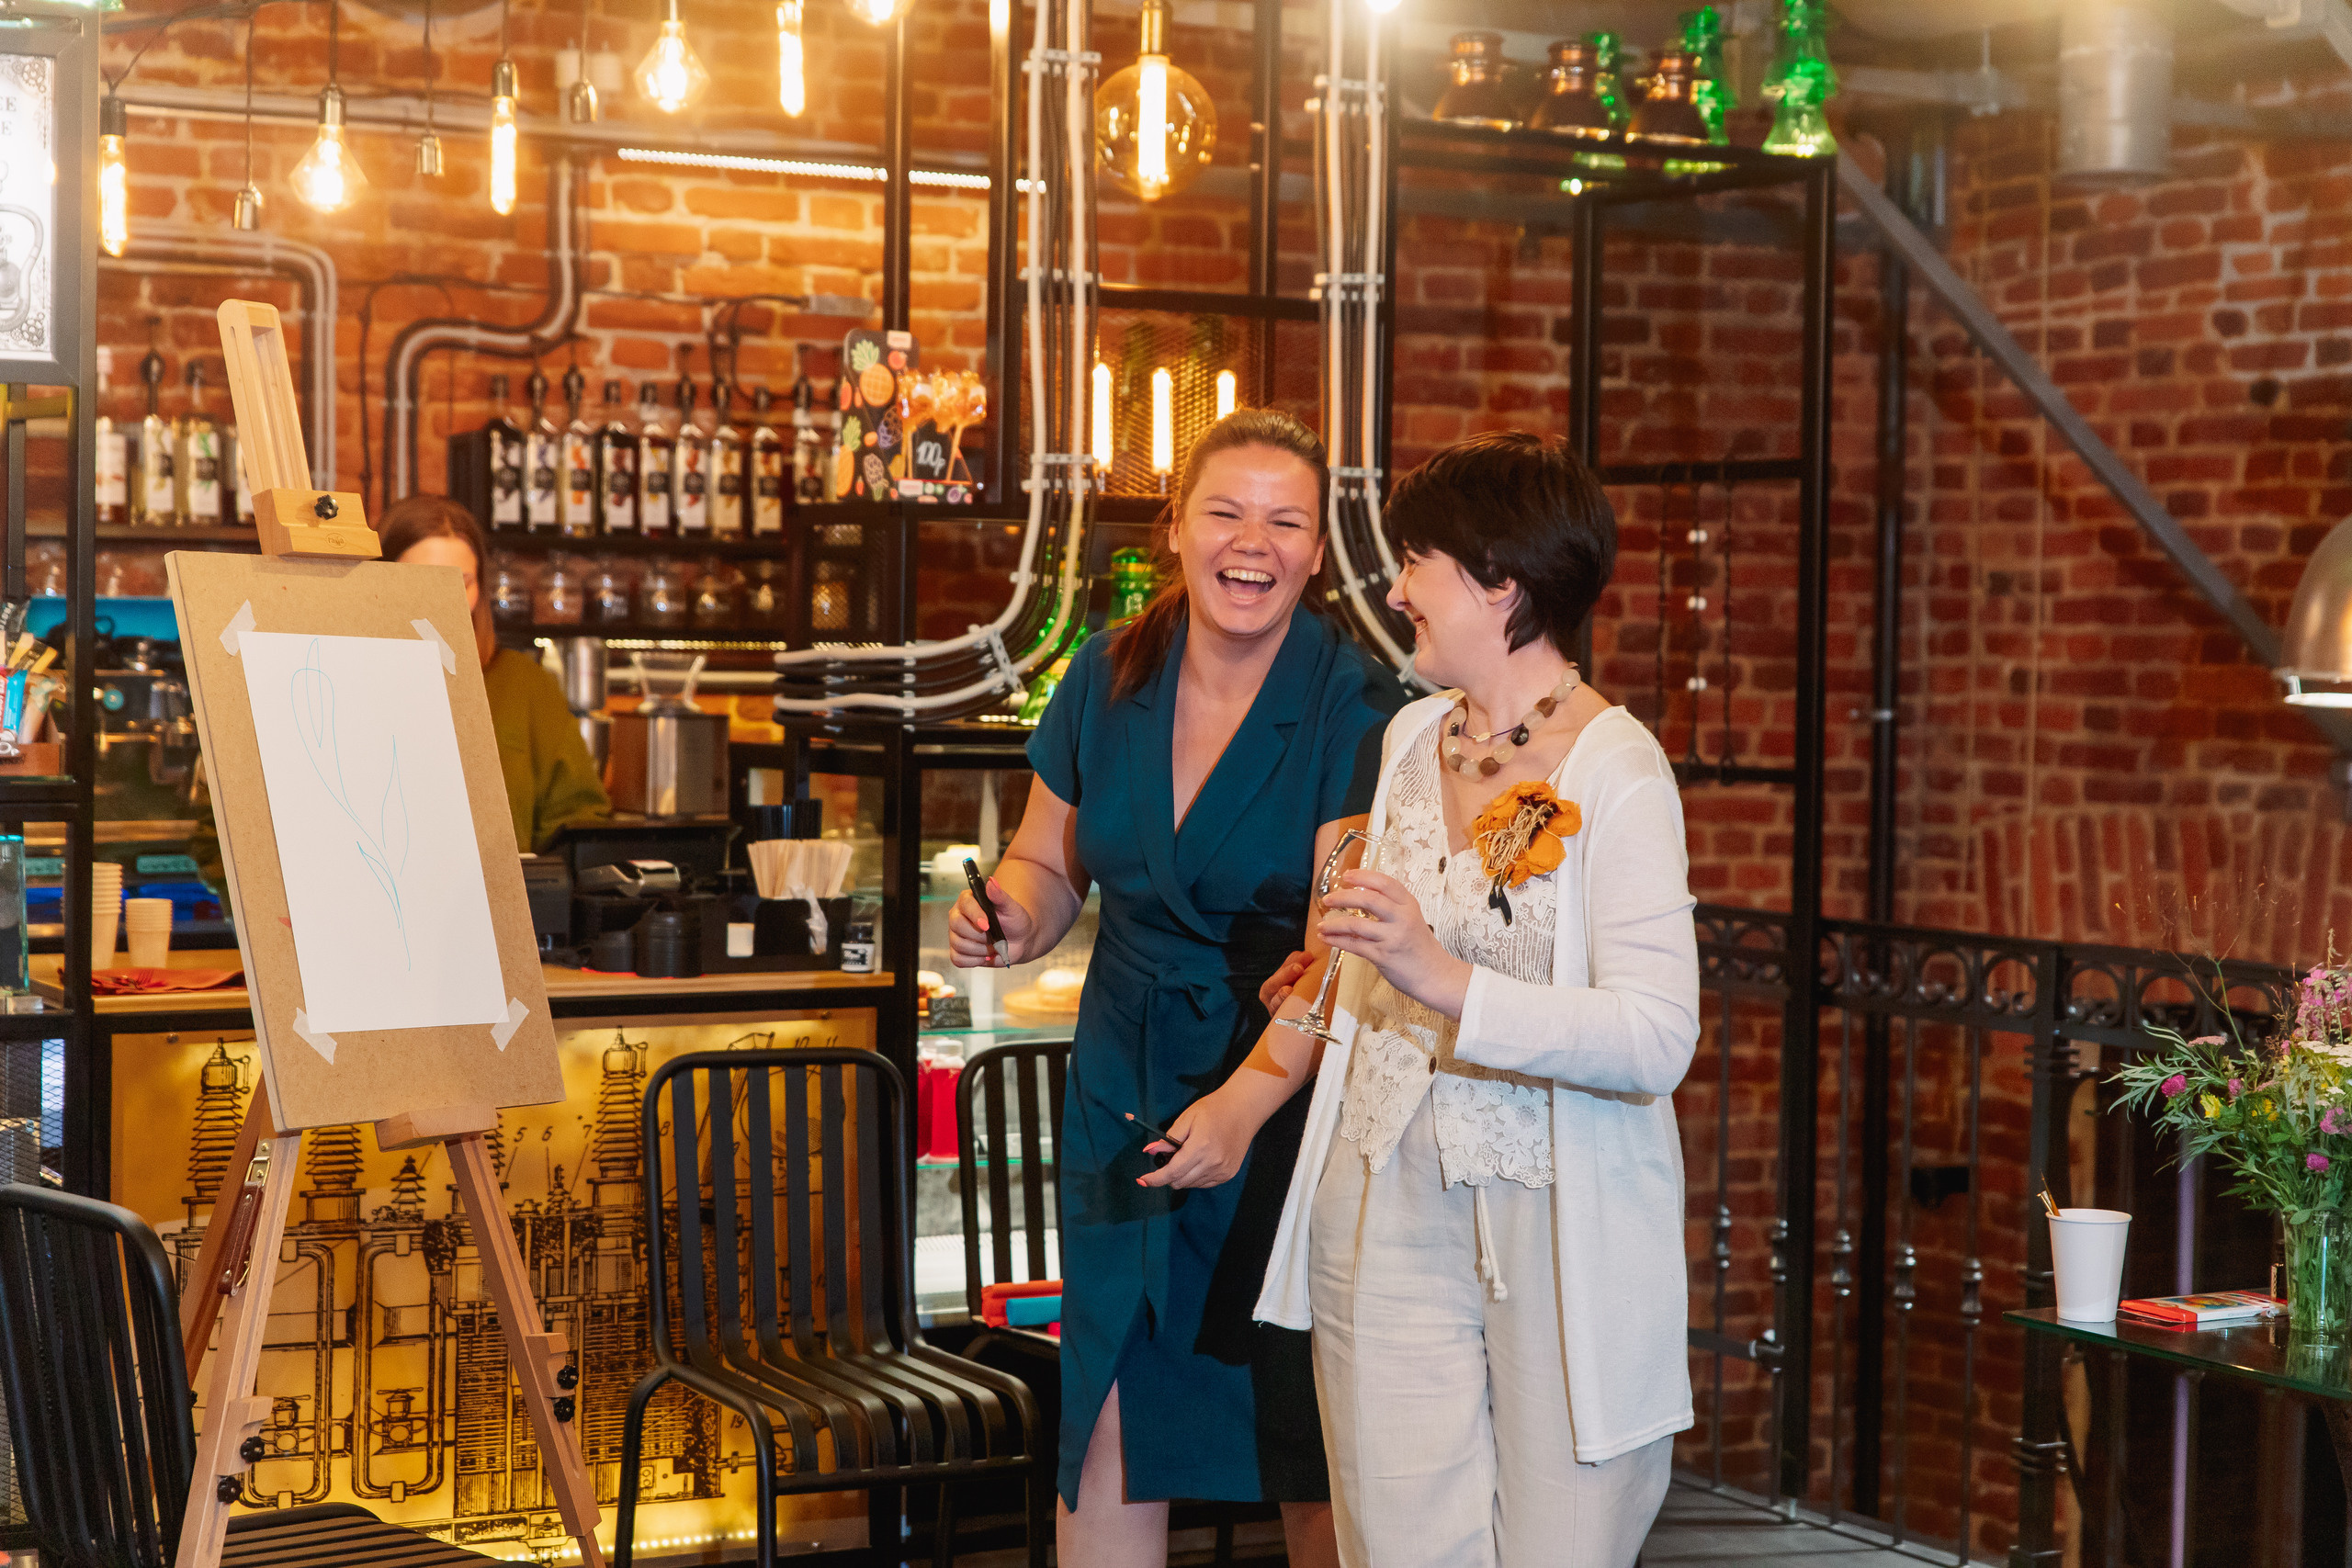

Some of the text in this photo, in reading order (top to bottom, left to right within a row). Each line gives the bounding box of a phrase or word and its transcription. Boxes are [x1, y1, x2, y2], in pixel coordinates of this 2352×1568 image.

[514, 1126, 527, 1142] 5
[541, 1126, 553, 1141] 6
[582, 1124, 593, 1138] 7
[660, 1121, 671, 1136] 8
